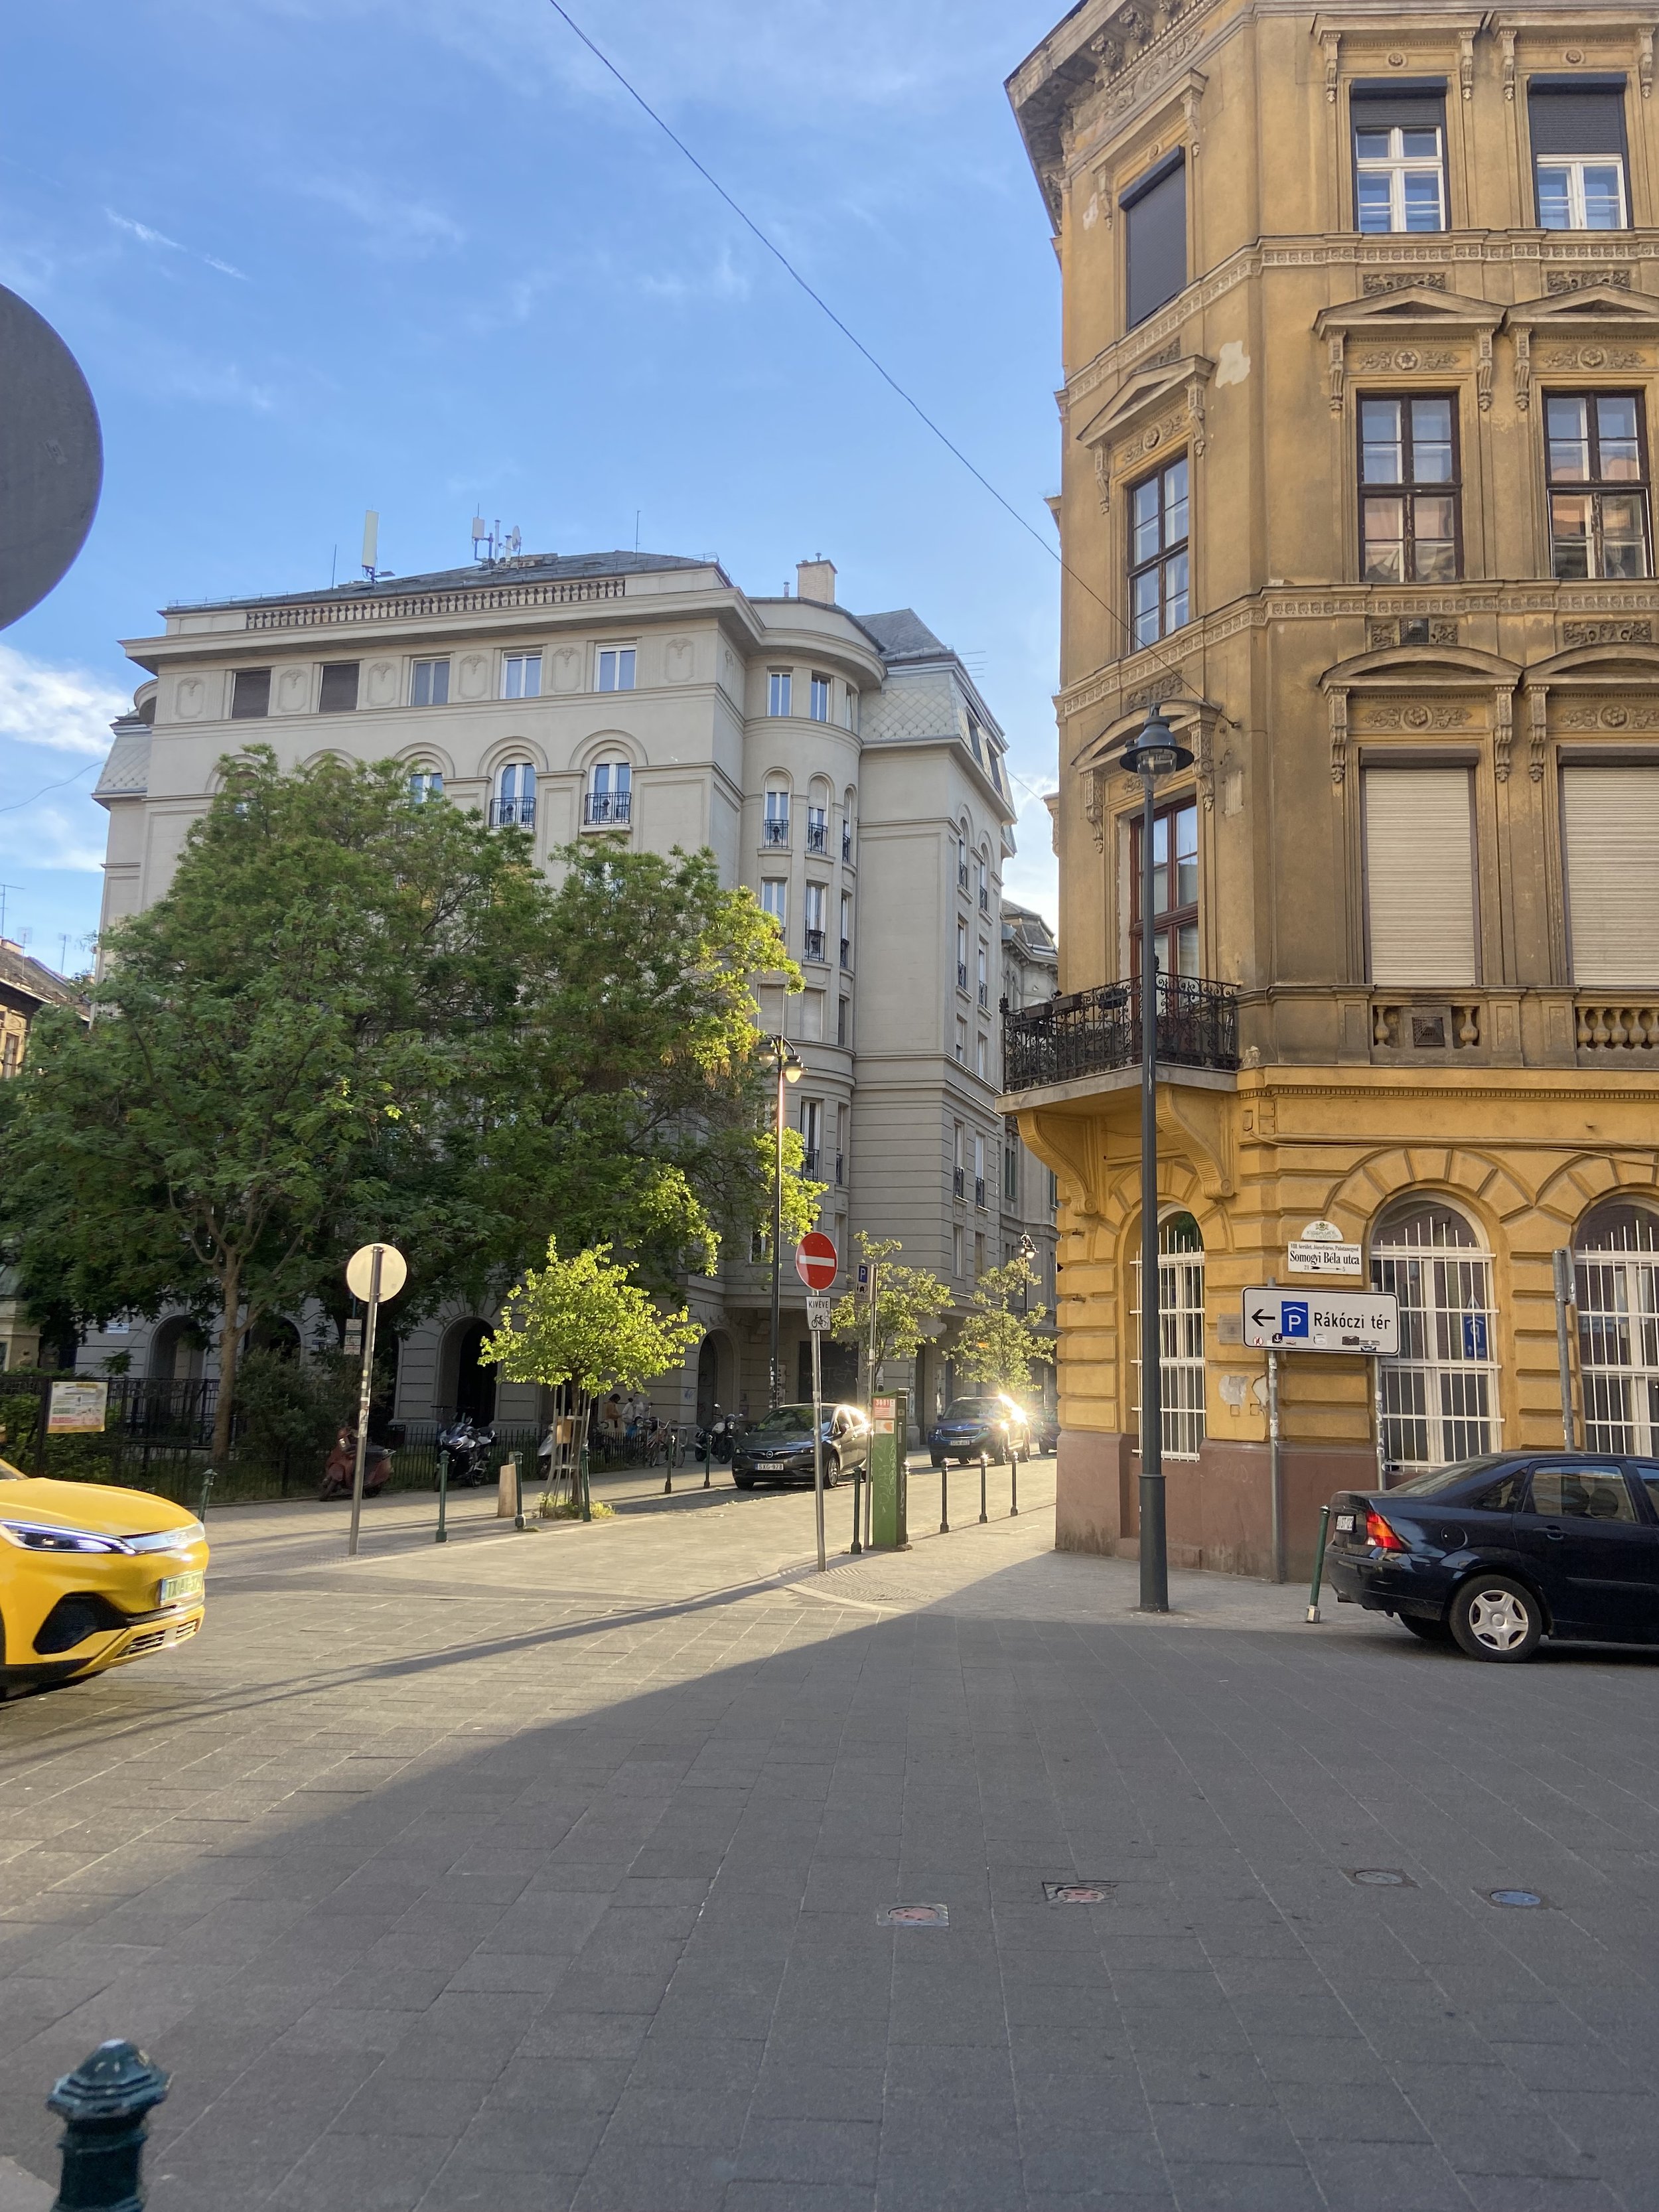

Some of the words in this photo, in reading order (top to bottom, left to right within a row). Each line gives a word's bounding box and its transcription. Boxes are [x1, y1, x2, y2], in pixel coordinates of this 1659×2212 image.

[1290, 1250, 1321, 1265] Somogyi
[1323, 1252, 1340, 1264] Béla
[1343, 1254, 1360, 1265] utca
[808, 1299, 829, 1308] KIVÉVE
[1288, 1315, 1301, 1332] P
[1314, 1311, 1364, 1329] Rákóczi
[1371, 1314, 1391, 1329] tér
